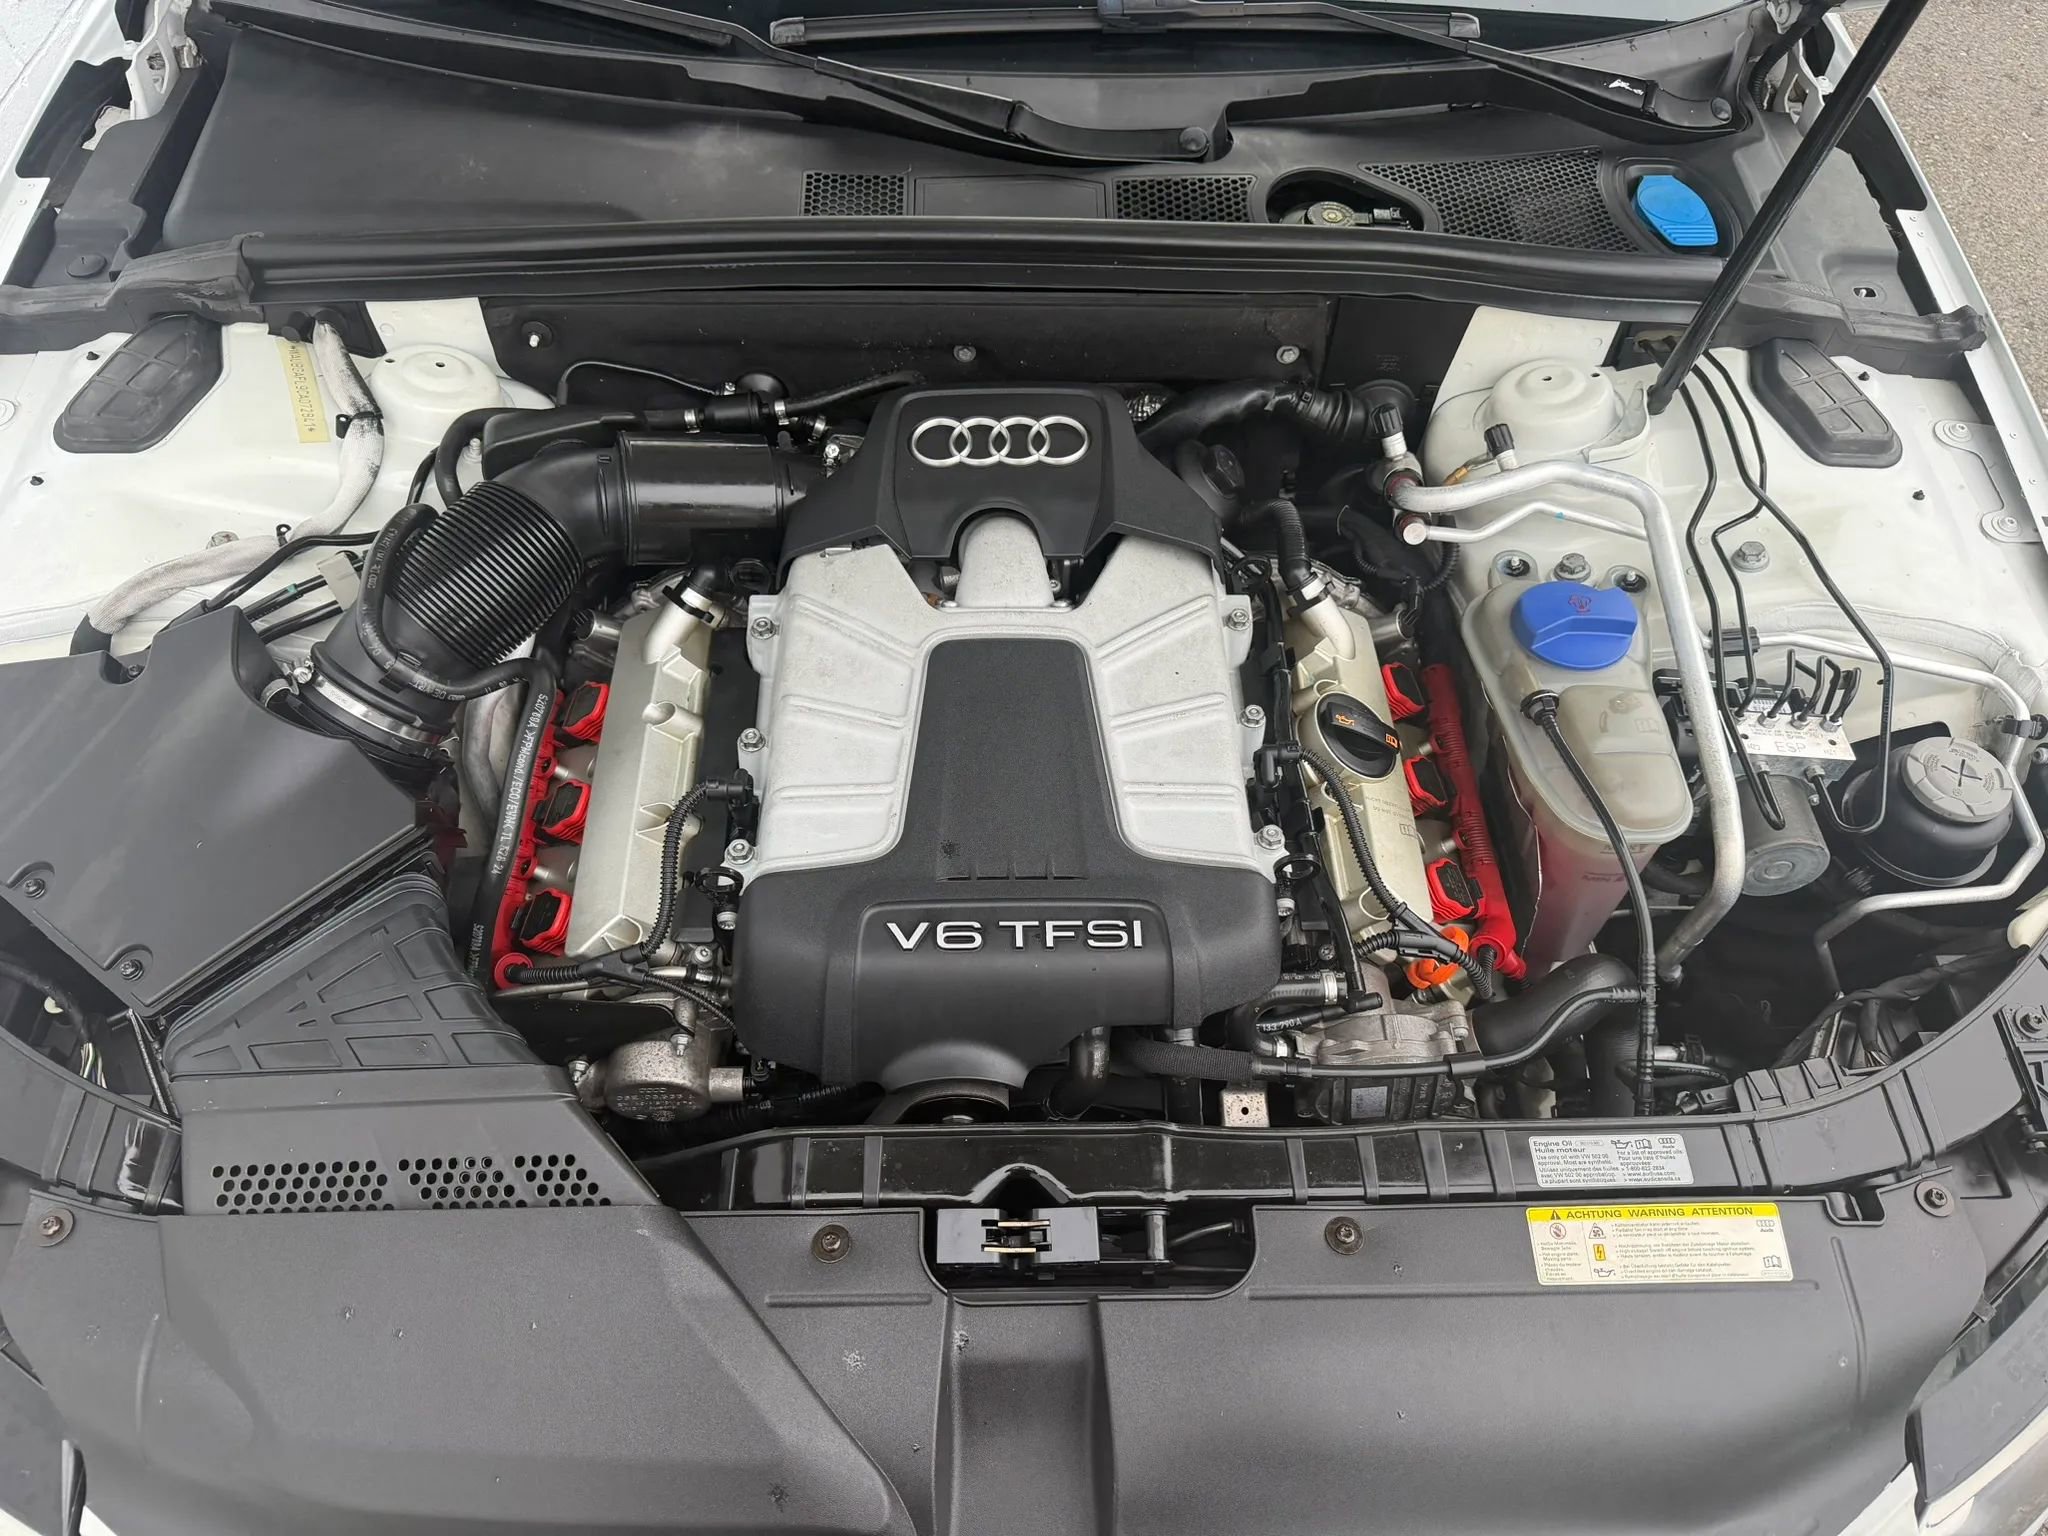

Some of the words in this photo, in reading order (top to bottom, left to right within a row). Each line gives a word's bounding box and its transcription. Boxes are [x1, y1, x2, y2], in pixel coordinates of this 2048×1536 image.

[1774, 741, 1806, 753] ESP
[887, 921, 982, 950] V6
[999, 920, 1143, 949] TFSI
[1566, 1209, 1622, 1219] ACHTUNG
[1628, 1208, 1685, 1218] WARNING
[1691, 1206, 1753, 1217] ATTENTION
